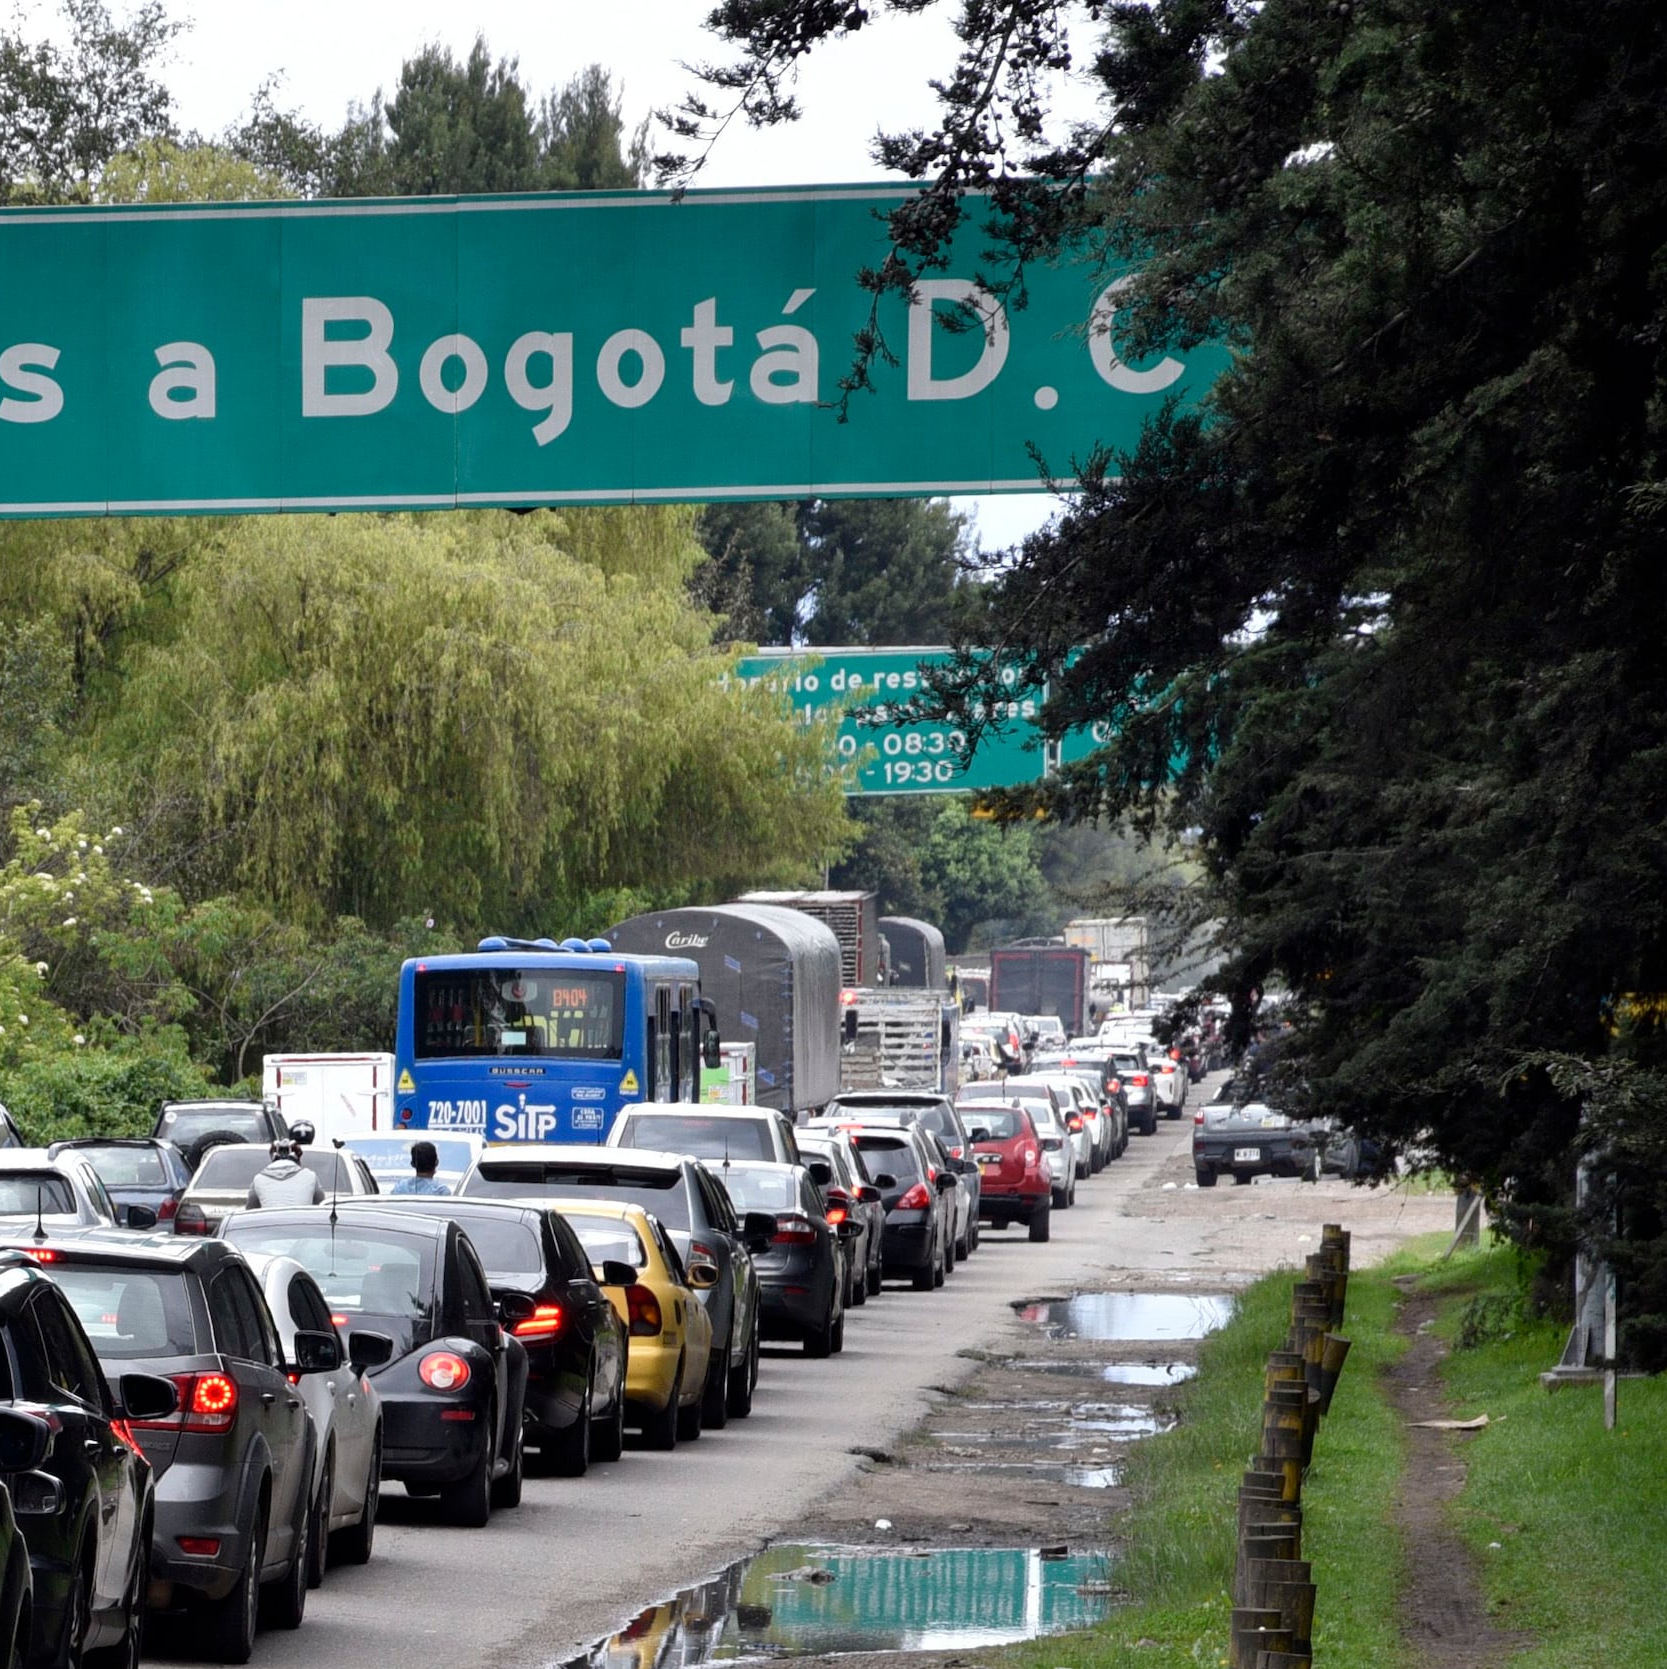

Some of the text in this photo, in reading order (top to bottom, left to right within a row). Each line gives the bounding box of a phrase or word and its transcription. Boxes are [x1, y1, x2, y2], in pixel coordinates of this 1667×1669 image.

[148, 340, 216, 419] a
[301, 287, 818, 446] Bogotá
[830, 668, 863, 691] de
[883, 731, 965, 755] 08:30
[884, 760, 954, 784] 19:30
[428, 1100, 486, 1124] Z20-7001
